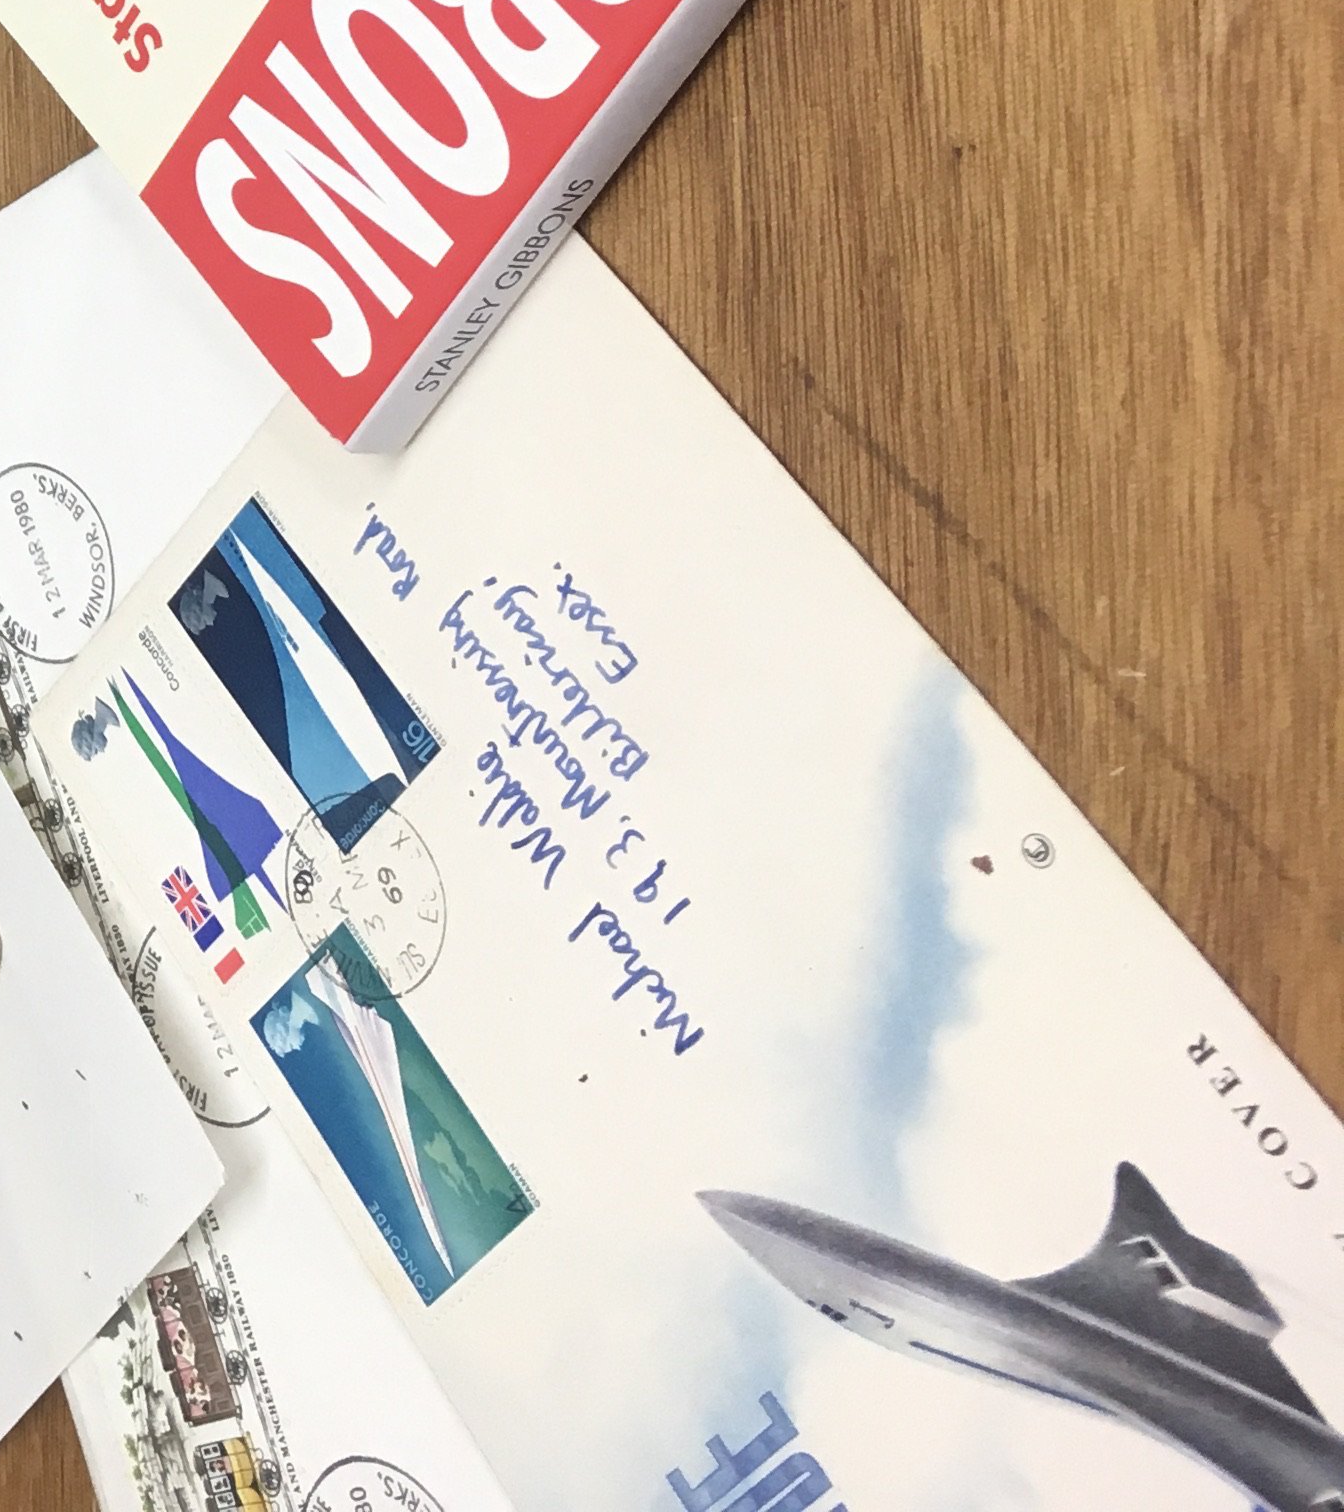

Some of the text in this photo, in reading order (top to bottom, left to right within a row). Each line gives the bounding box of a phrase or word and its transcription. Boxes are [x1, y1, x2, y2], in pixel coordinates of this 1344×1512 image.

[415, 297, 500, 392] STANLEY
[495, 179, 594, 290] GIBBONS
[10, 490, 55, 586] MAR 1980
[32, 473, 84, 520] BERKS.
[253, 489, 287, 534] HARRISON
[138, 630, 180, 692] Concorde
[552, 562, 638, 684] Essex.
[407, 691, 447, 748] GENTLEMAN
[65, 796, 110, 903] LIVERPOOL AND
[339, 798, 385, 850] Concorde
[377, 867, 403, 904] 69
[568, 901, 705, 1056] Michael
[1186, 1032, 1318, 1190] COVER
[368, 1200, 434, 1301] CONCORDE
[222, 1253, 301, 1494] AND MANCHESTER RAILWAY 1830
